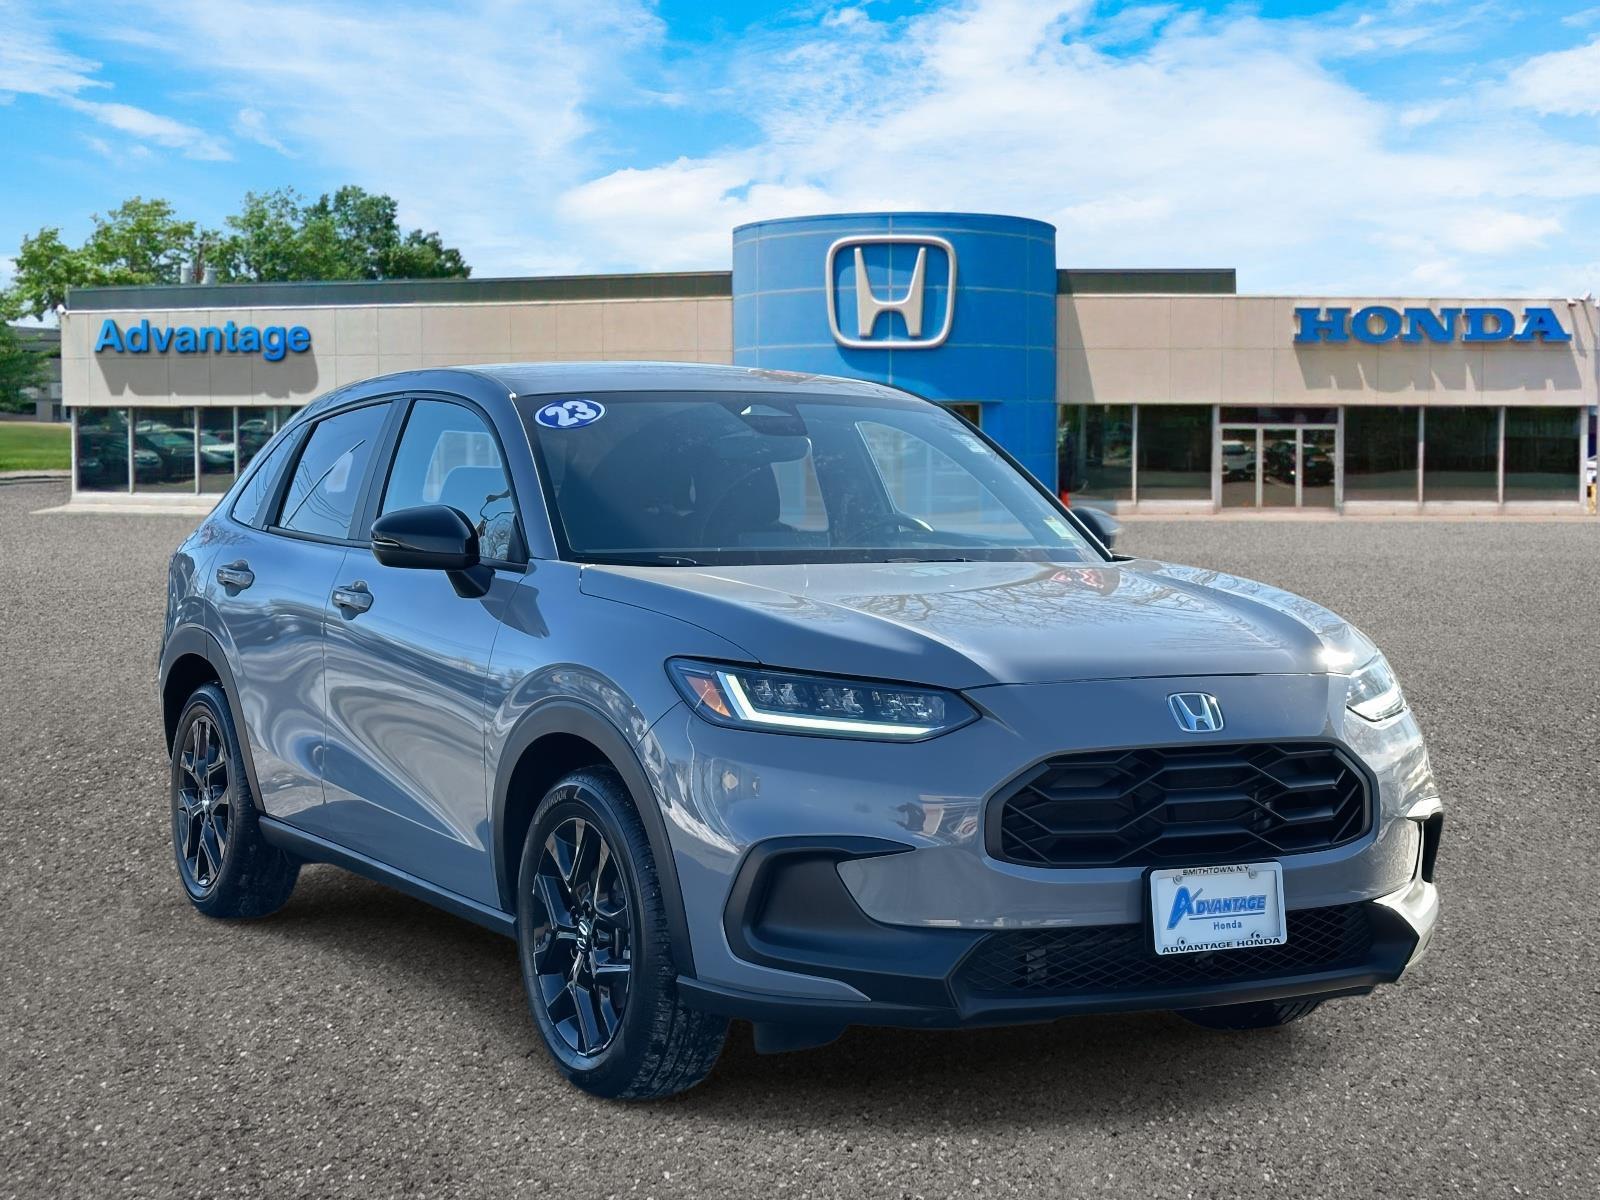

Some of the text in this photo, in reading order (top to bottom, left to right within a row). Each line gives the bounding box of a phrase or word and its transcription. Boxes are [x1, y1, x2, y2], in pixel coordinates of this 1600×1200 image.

[95, 319, 312, 362] Advantage
[1294, 305, 1572, 345] HONDA
[544, 400, 597, 427] 23
[1167, 886, 1266, 930] ADVANTAGE
[1213, 919, 1242, 931] Honda
[1162, 937, 1281, 954] ADVANTAGE HONDA
